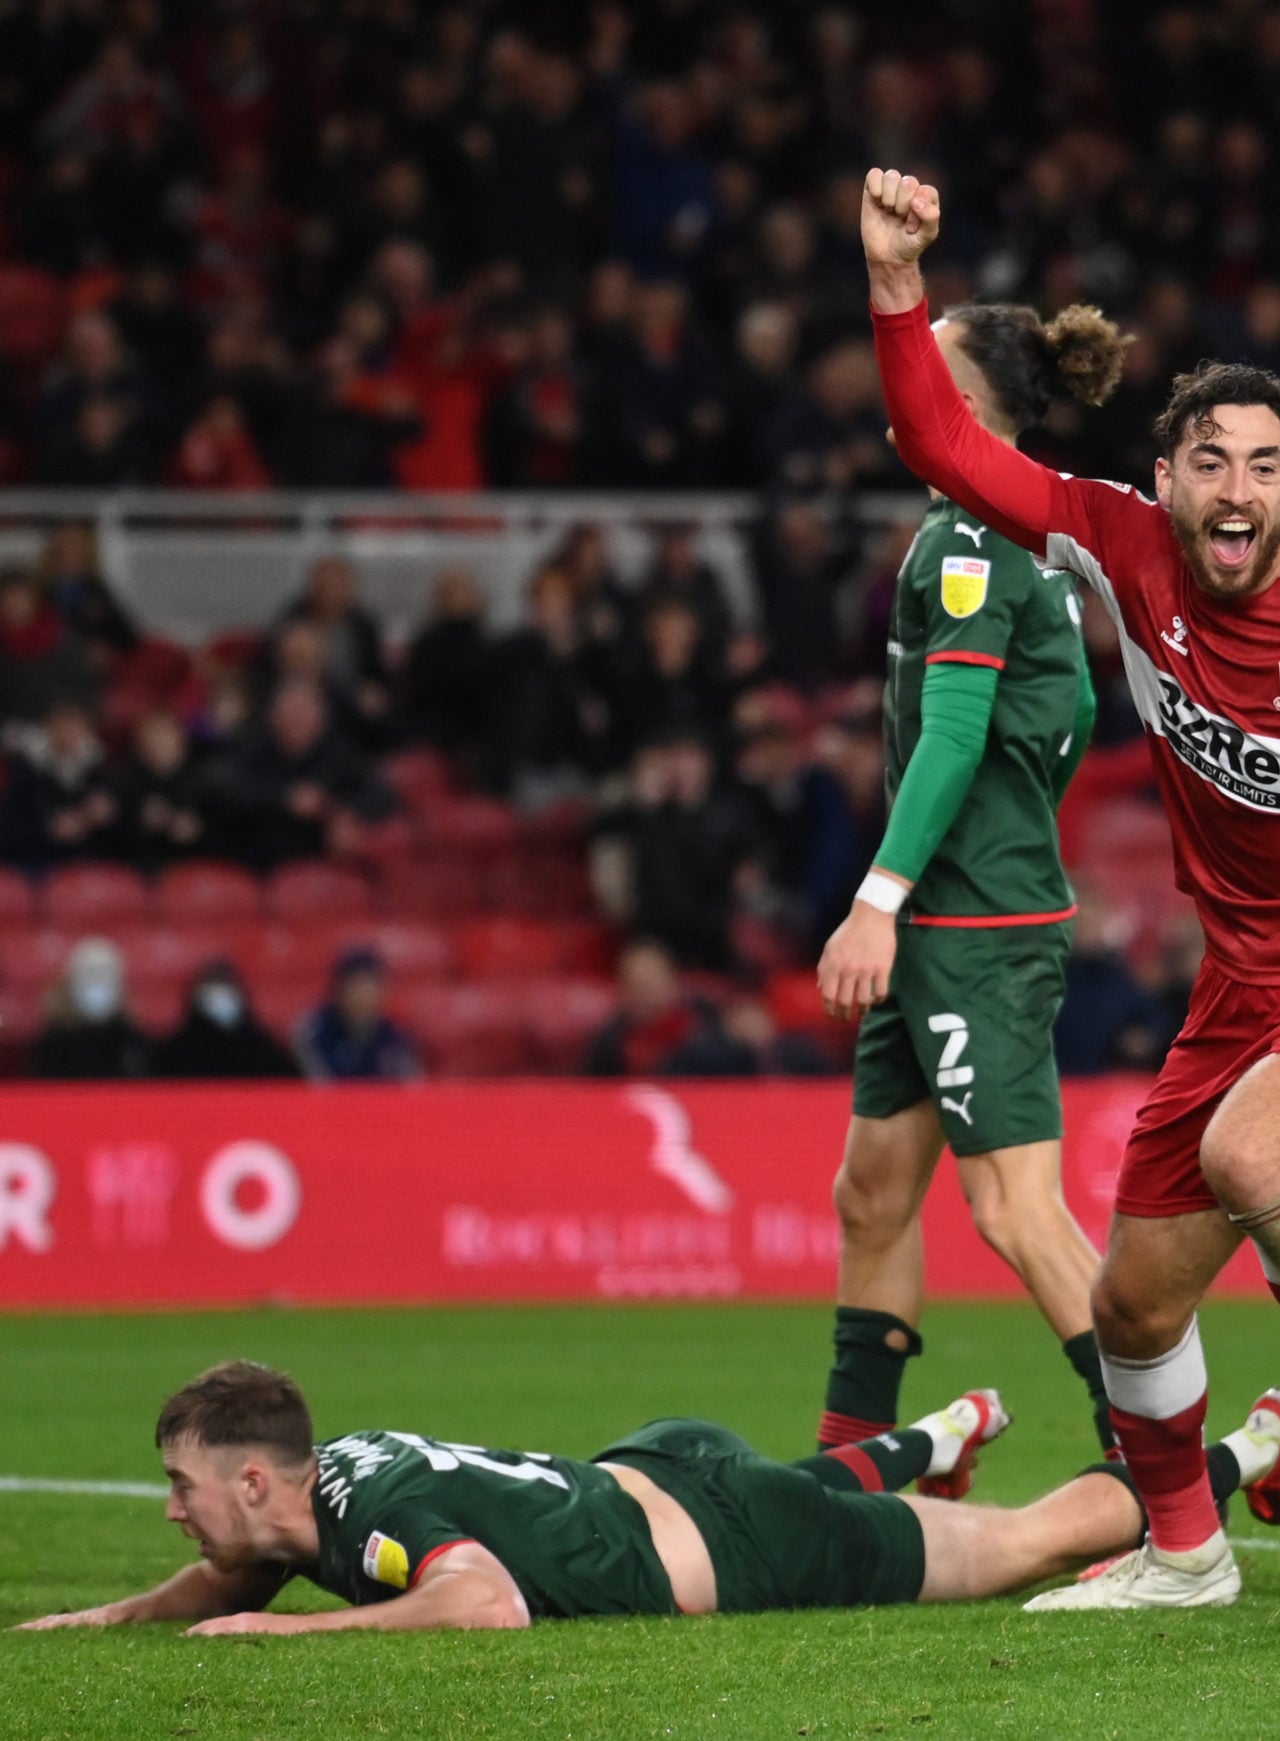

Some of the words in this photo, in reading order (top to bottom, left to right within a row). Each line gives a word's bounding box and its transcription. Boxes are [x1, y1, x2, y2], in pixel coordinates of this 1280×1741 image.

[1180, 743, 1199, 762] SET
[1233, 781, 1277, 806] LIMITS
[927, 1012, 975, 1089] 2
